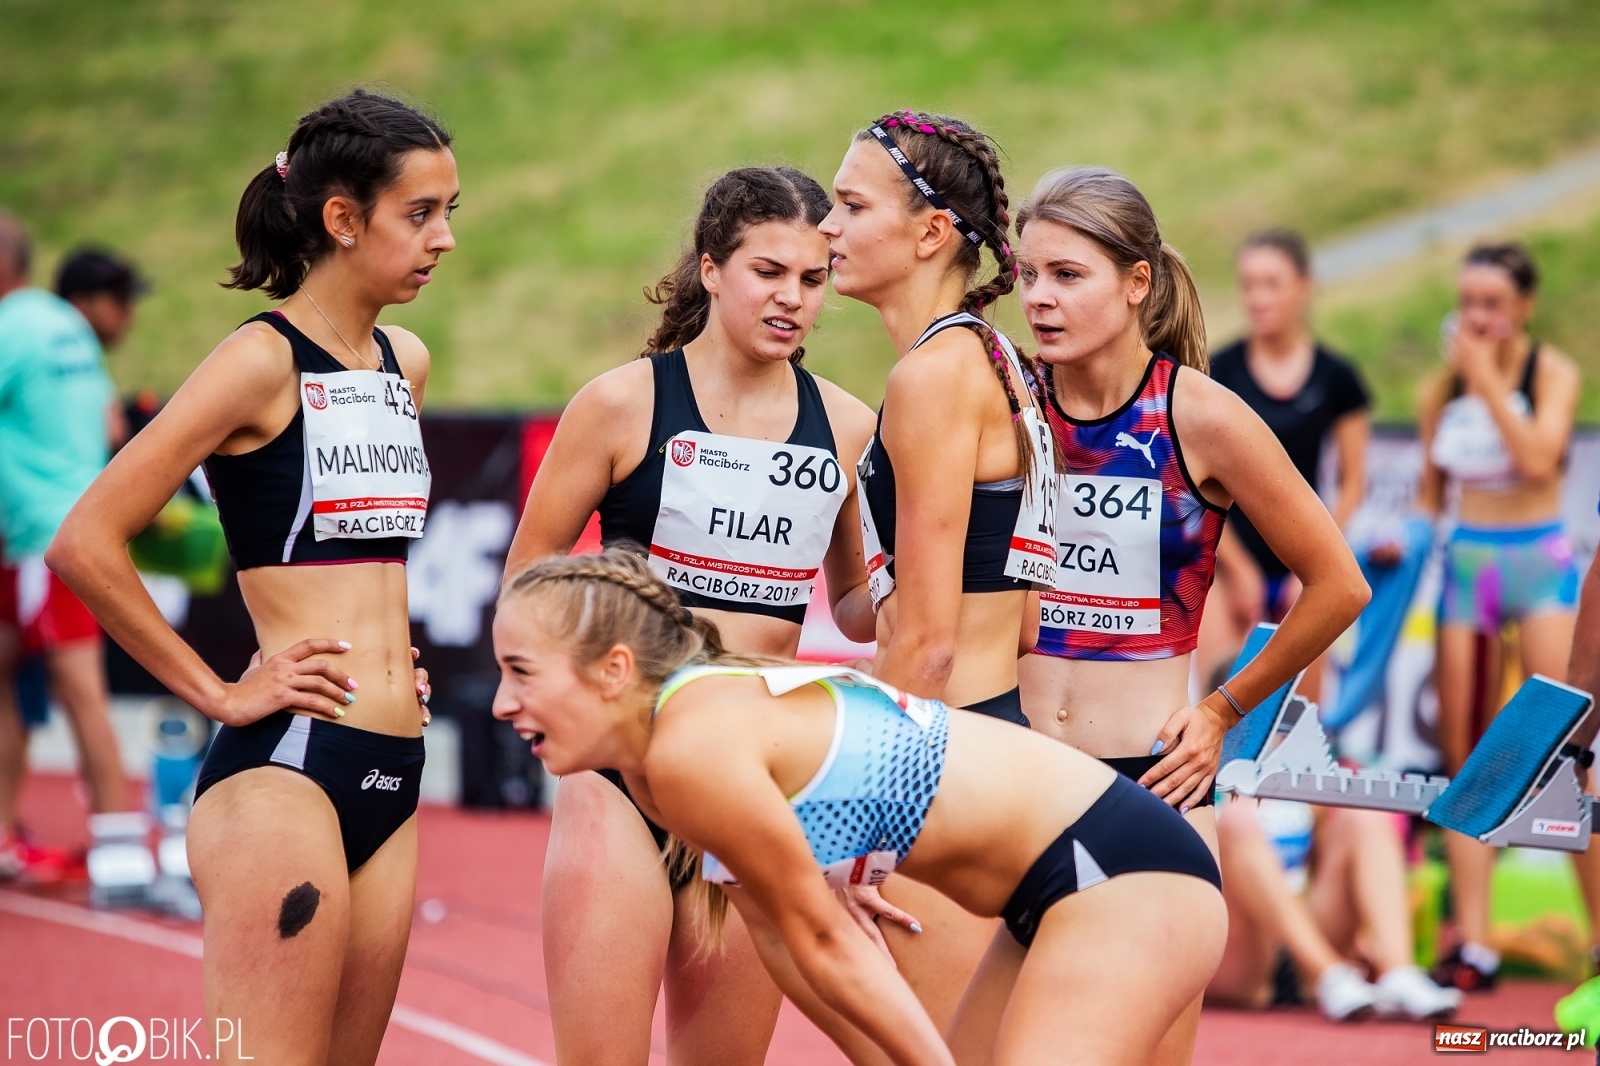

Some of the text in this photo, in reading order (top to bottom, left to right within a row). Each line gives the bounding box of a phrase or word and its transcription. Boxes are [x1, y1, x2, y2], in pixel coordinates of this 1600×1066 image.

[888, 147, 909, 166] NIKE
[912, 177, 936, 197] NIKE
[943, 208, 963, 226] NIKE
[329, 386, 356, 394] MIASTO
[331, 392, 376, 406] Racibórz
[316, 444, 429, 477] MALINOWSK
[699, 455, 750, 472] Racibórz
[700, 448, 728, 458] MIASTO
[768, 451, 841, 493] 360
[335, 502, 348, 510] 73.
[1073, 482, 1152, 520] 364
[338, 510, 417, 534] RACIBÓRZ
[708, 506, 793, 546] FILAR
[668, 552, 682, 562] 73.
[683, 556, 706, 567] PZLA
[707, 560, 766, 576] MISTRZOSTWA
[767, 570, 794, 578] POLSKI
[1059, 542, 1120, 576] ZGA
[666, 566, 799, 602] RACIBÓRZ 2019
[1090, 598, 1120, 606] POLSKI
[1041, 604, 1135, 630] BÓRZ 2019
